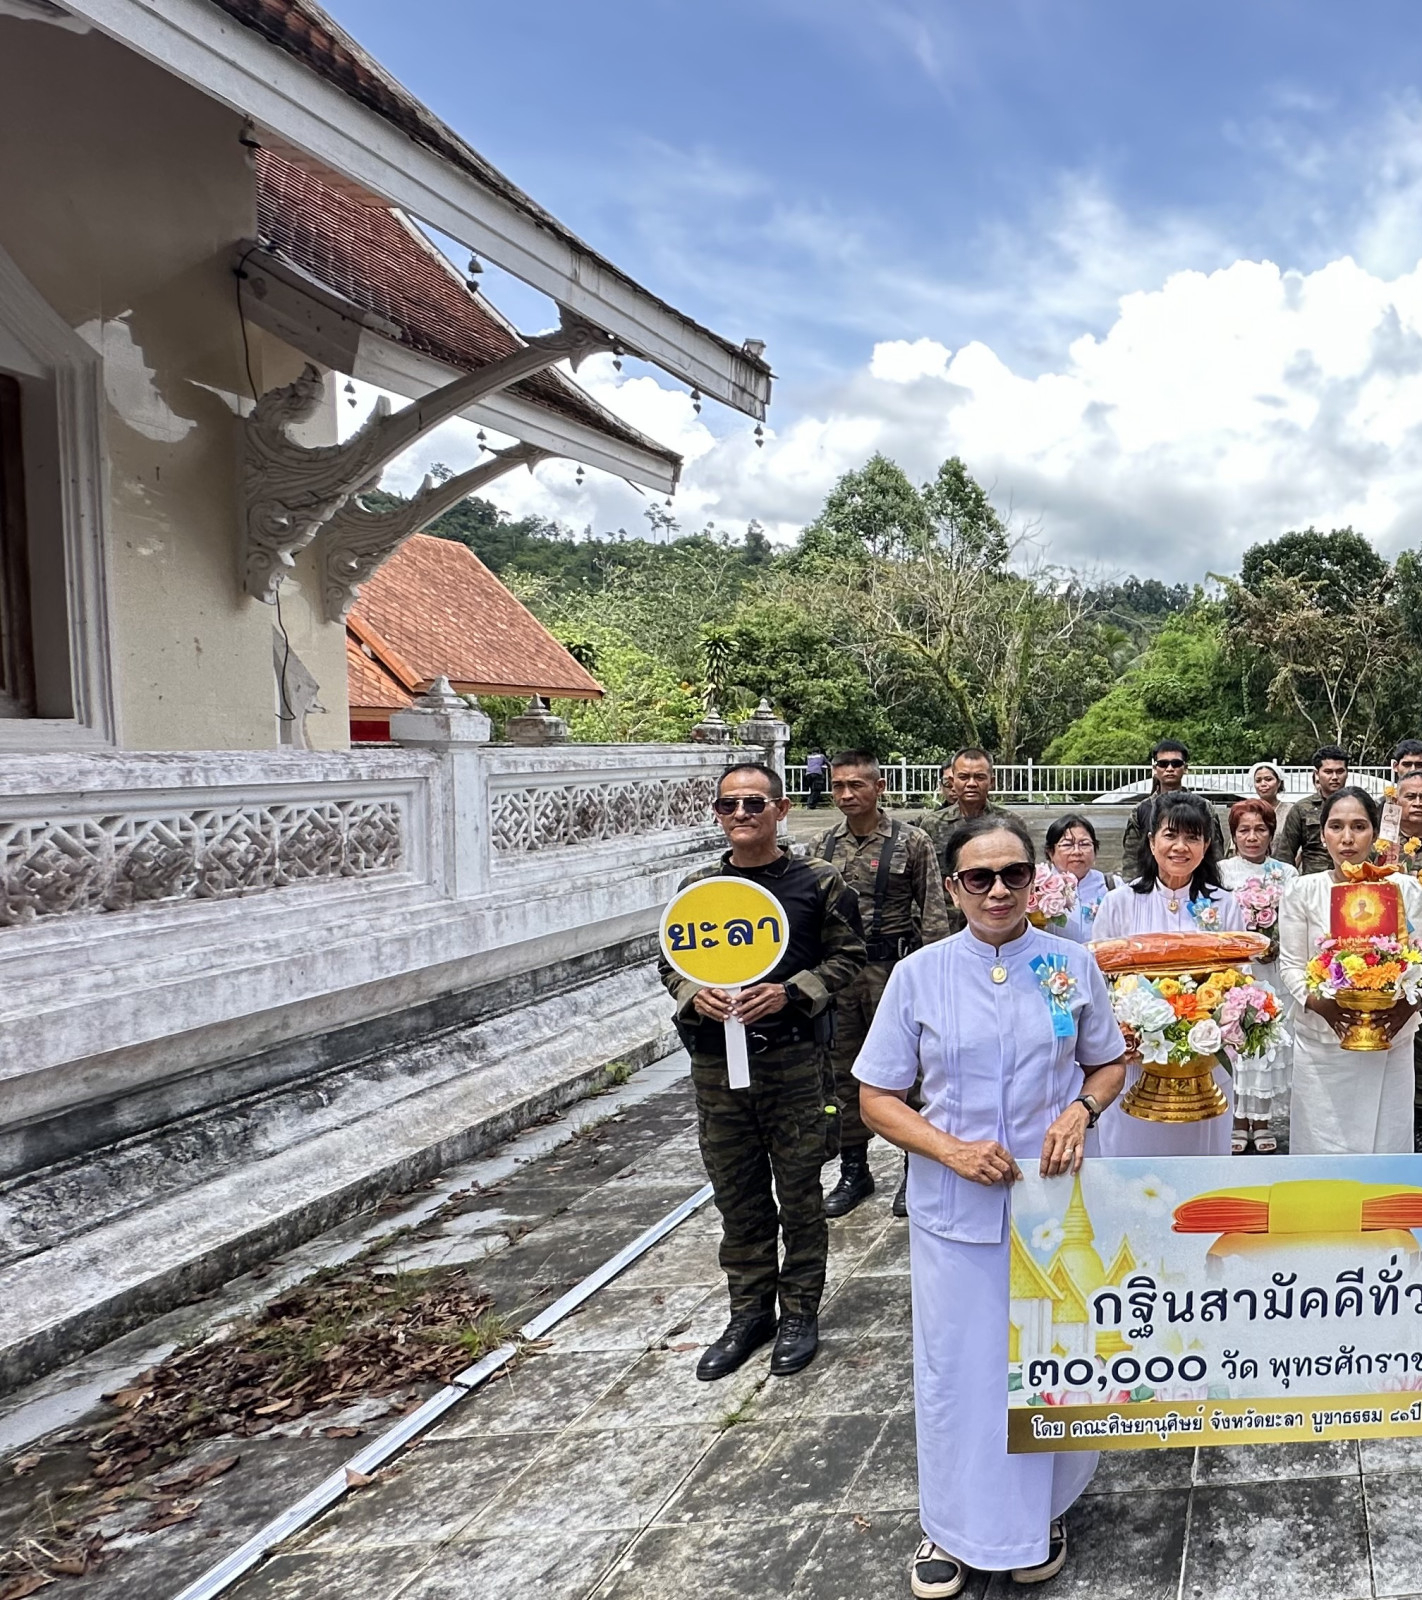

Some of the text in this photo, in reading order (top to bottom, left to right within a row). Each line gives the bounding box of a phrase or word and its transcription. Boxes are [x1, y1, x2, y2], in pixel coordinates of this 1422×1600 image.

[667, 916, 780, 951] ยะลา
[1028, 1355, 1207, 1392] ๓๐,๐๐๐
[1221, 1349, 1258, 1380] วัด
[1032, 1416, 1064, 1437] โดย
[1072, 1405, 1204, 1439] คณะศิษยานุศิษย์
[1210, 1410, 1303, 1430] จังหวัดยะลา
